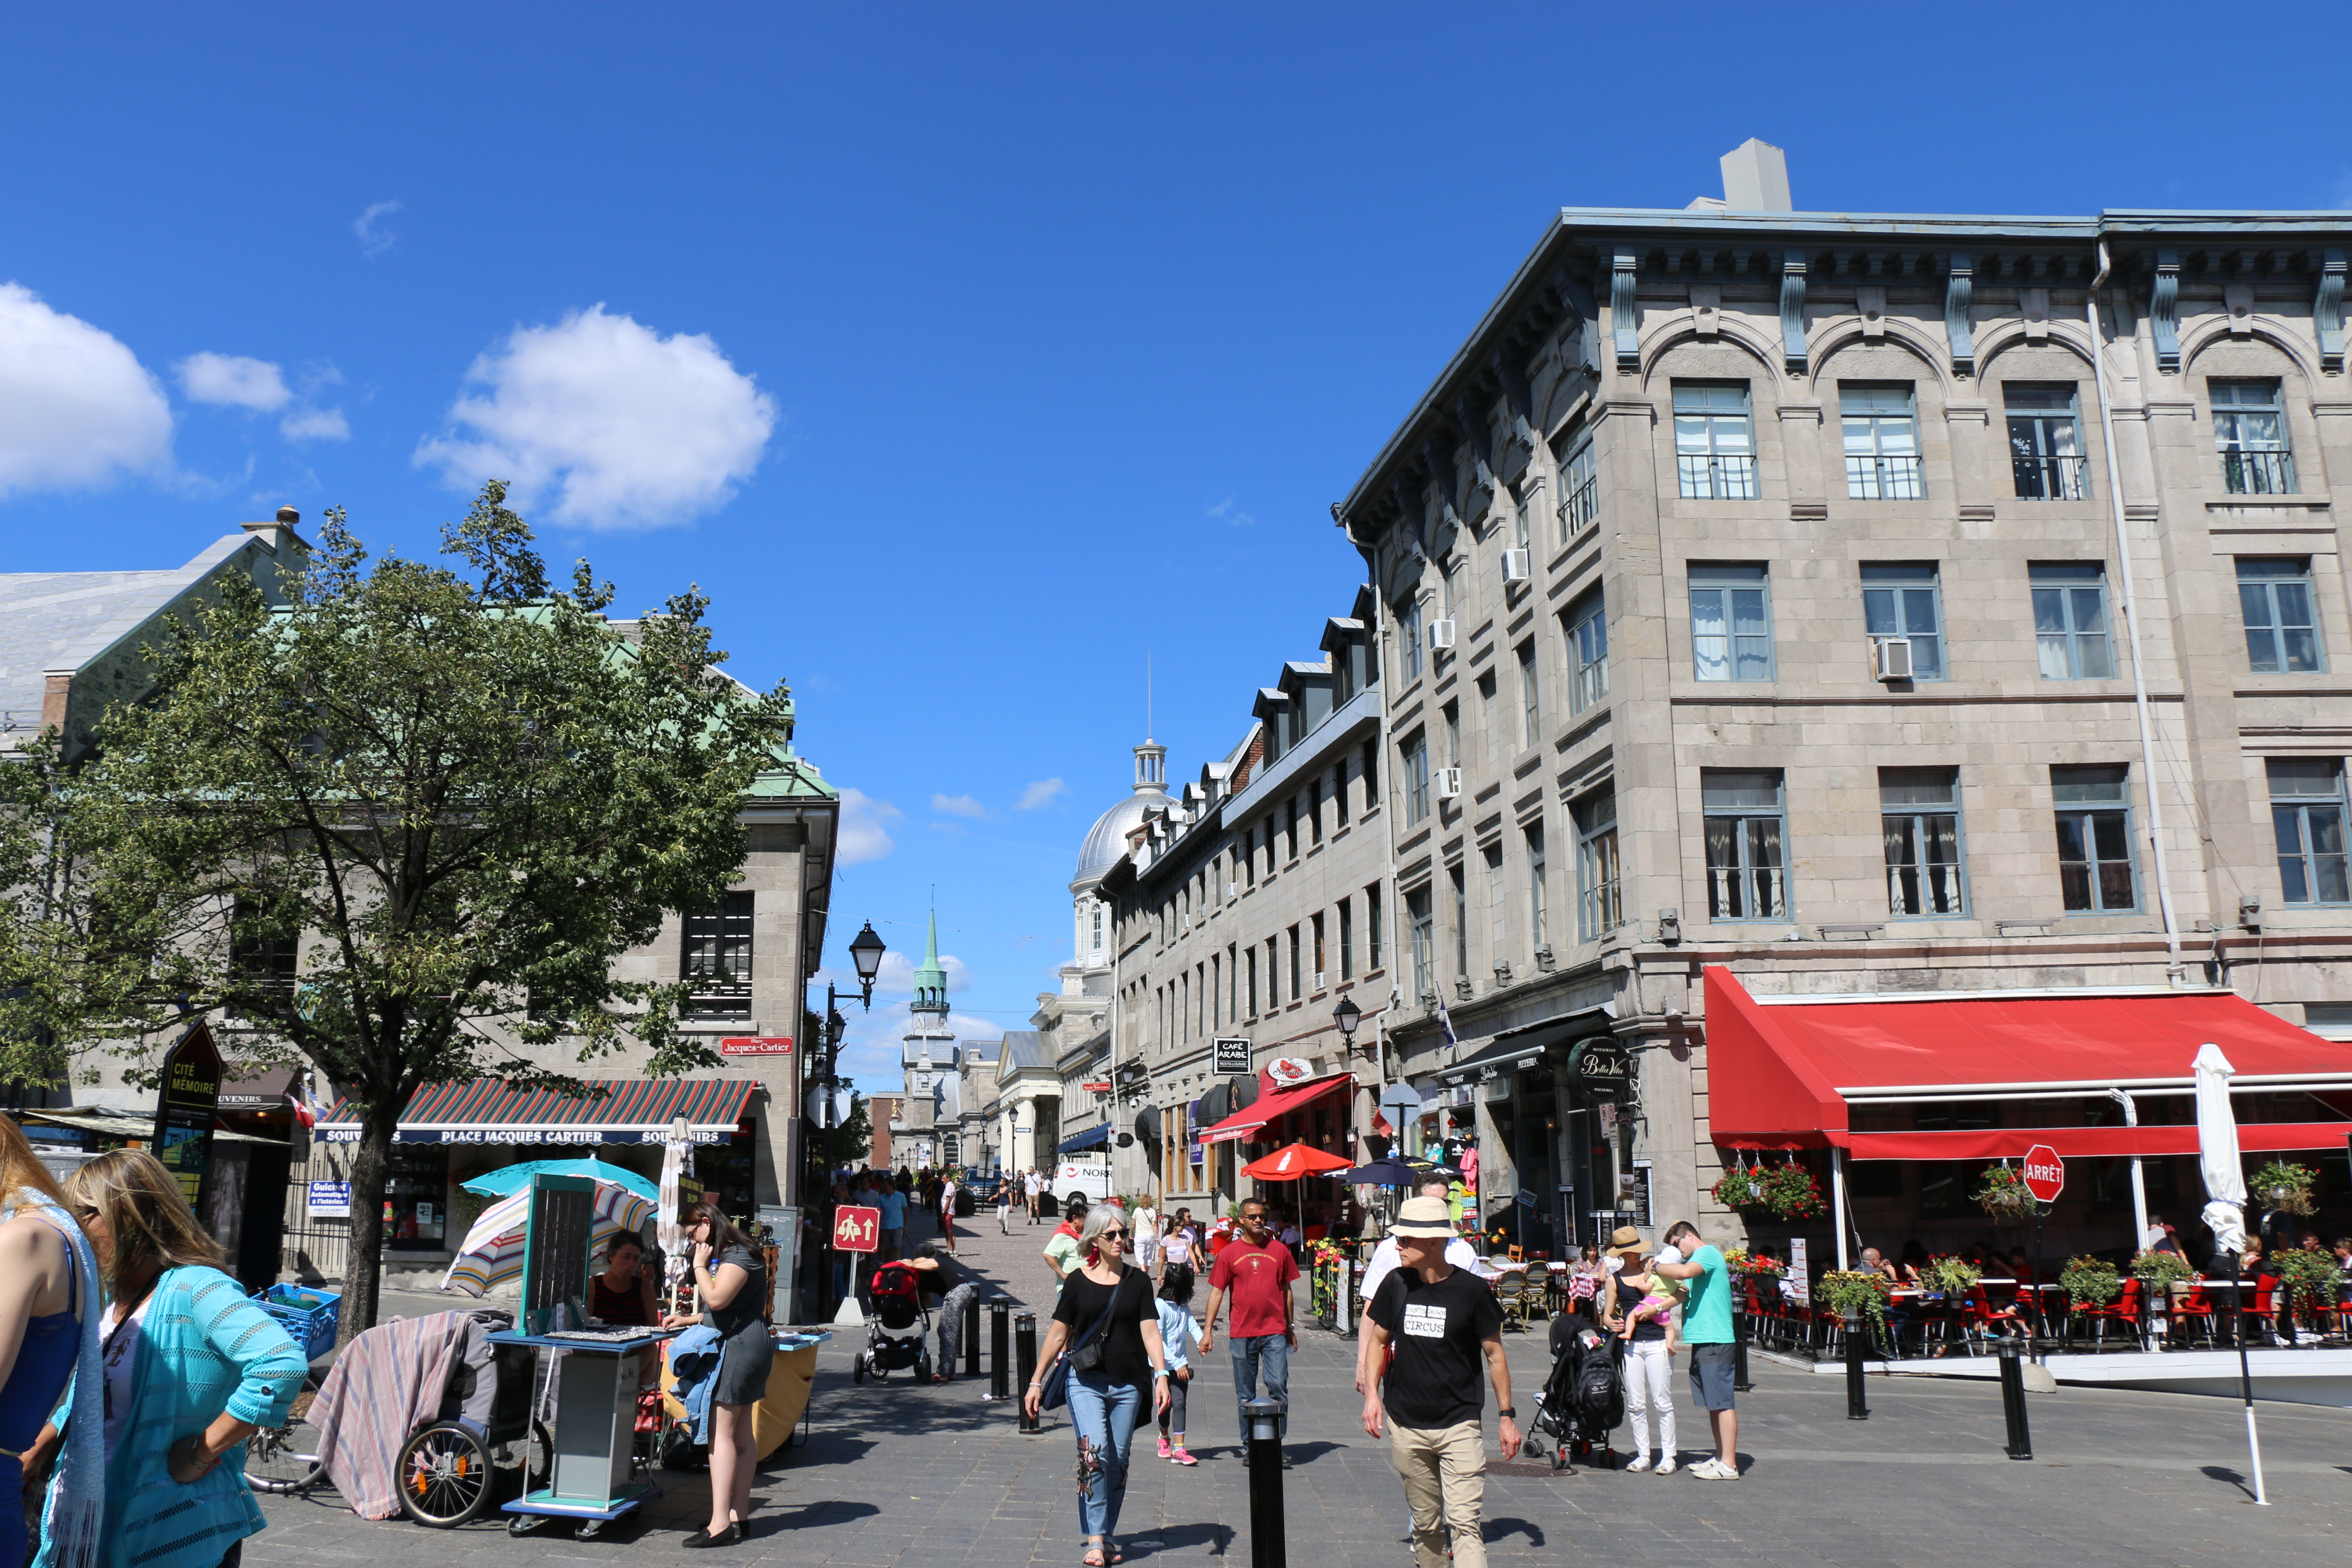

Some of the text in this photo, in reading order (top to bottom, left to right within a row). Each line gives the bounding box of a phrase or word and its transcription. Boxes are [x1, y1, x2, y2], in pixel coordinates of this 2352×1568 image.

[725, 1043, 789, 1054] Jacques-Cartier
[1218, 1050, 1247, 1059] ARABE
[174, 1063, 195, 1076] CITÉ
[1518, 1057, 1539, 1069] PIZZERIA
[1580, 1054, 1609, 1075] Bella
[1608, 1057, 1627, 1075] Vita
[172, 1076, 214, 1094] MÉMOIRE
[326, 1130, 719, 1144] SOUVS PLACE JACQUES CARTIER SOUIRS
[2027, 1164, 2061, 1182] ARRÊT
[313, 1182, 346, 1191] Guichet
[1520, 1191, 1536, 1203] OUVERT
[1405, 1320, 1444, 1333] CIRCUS
